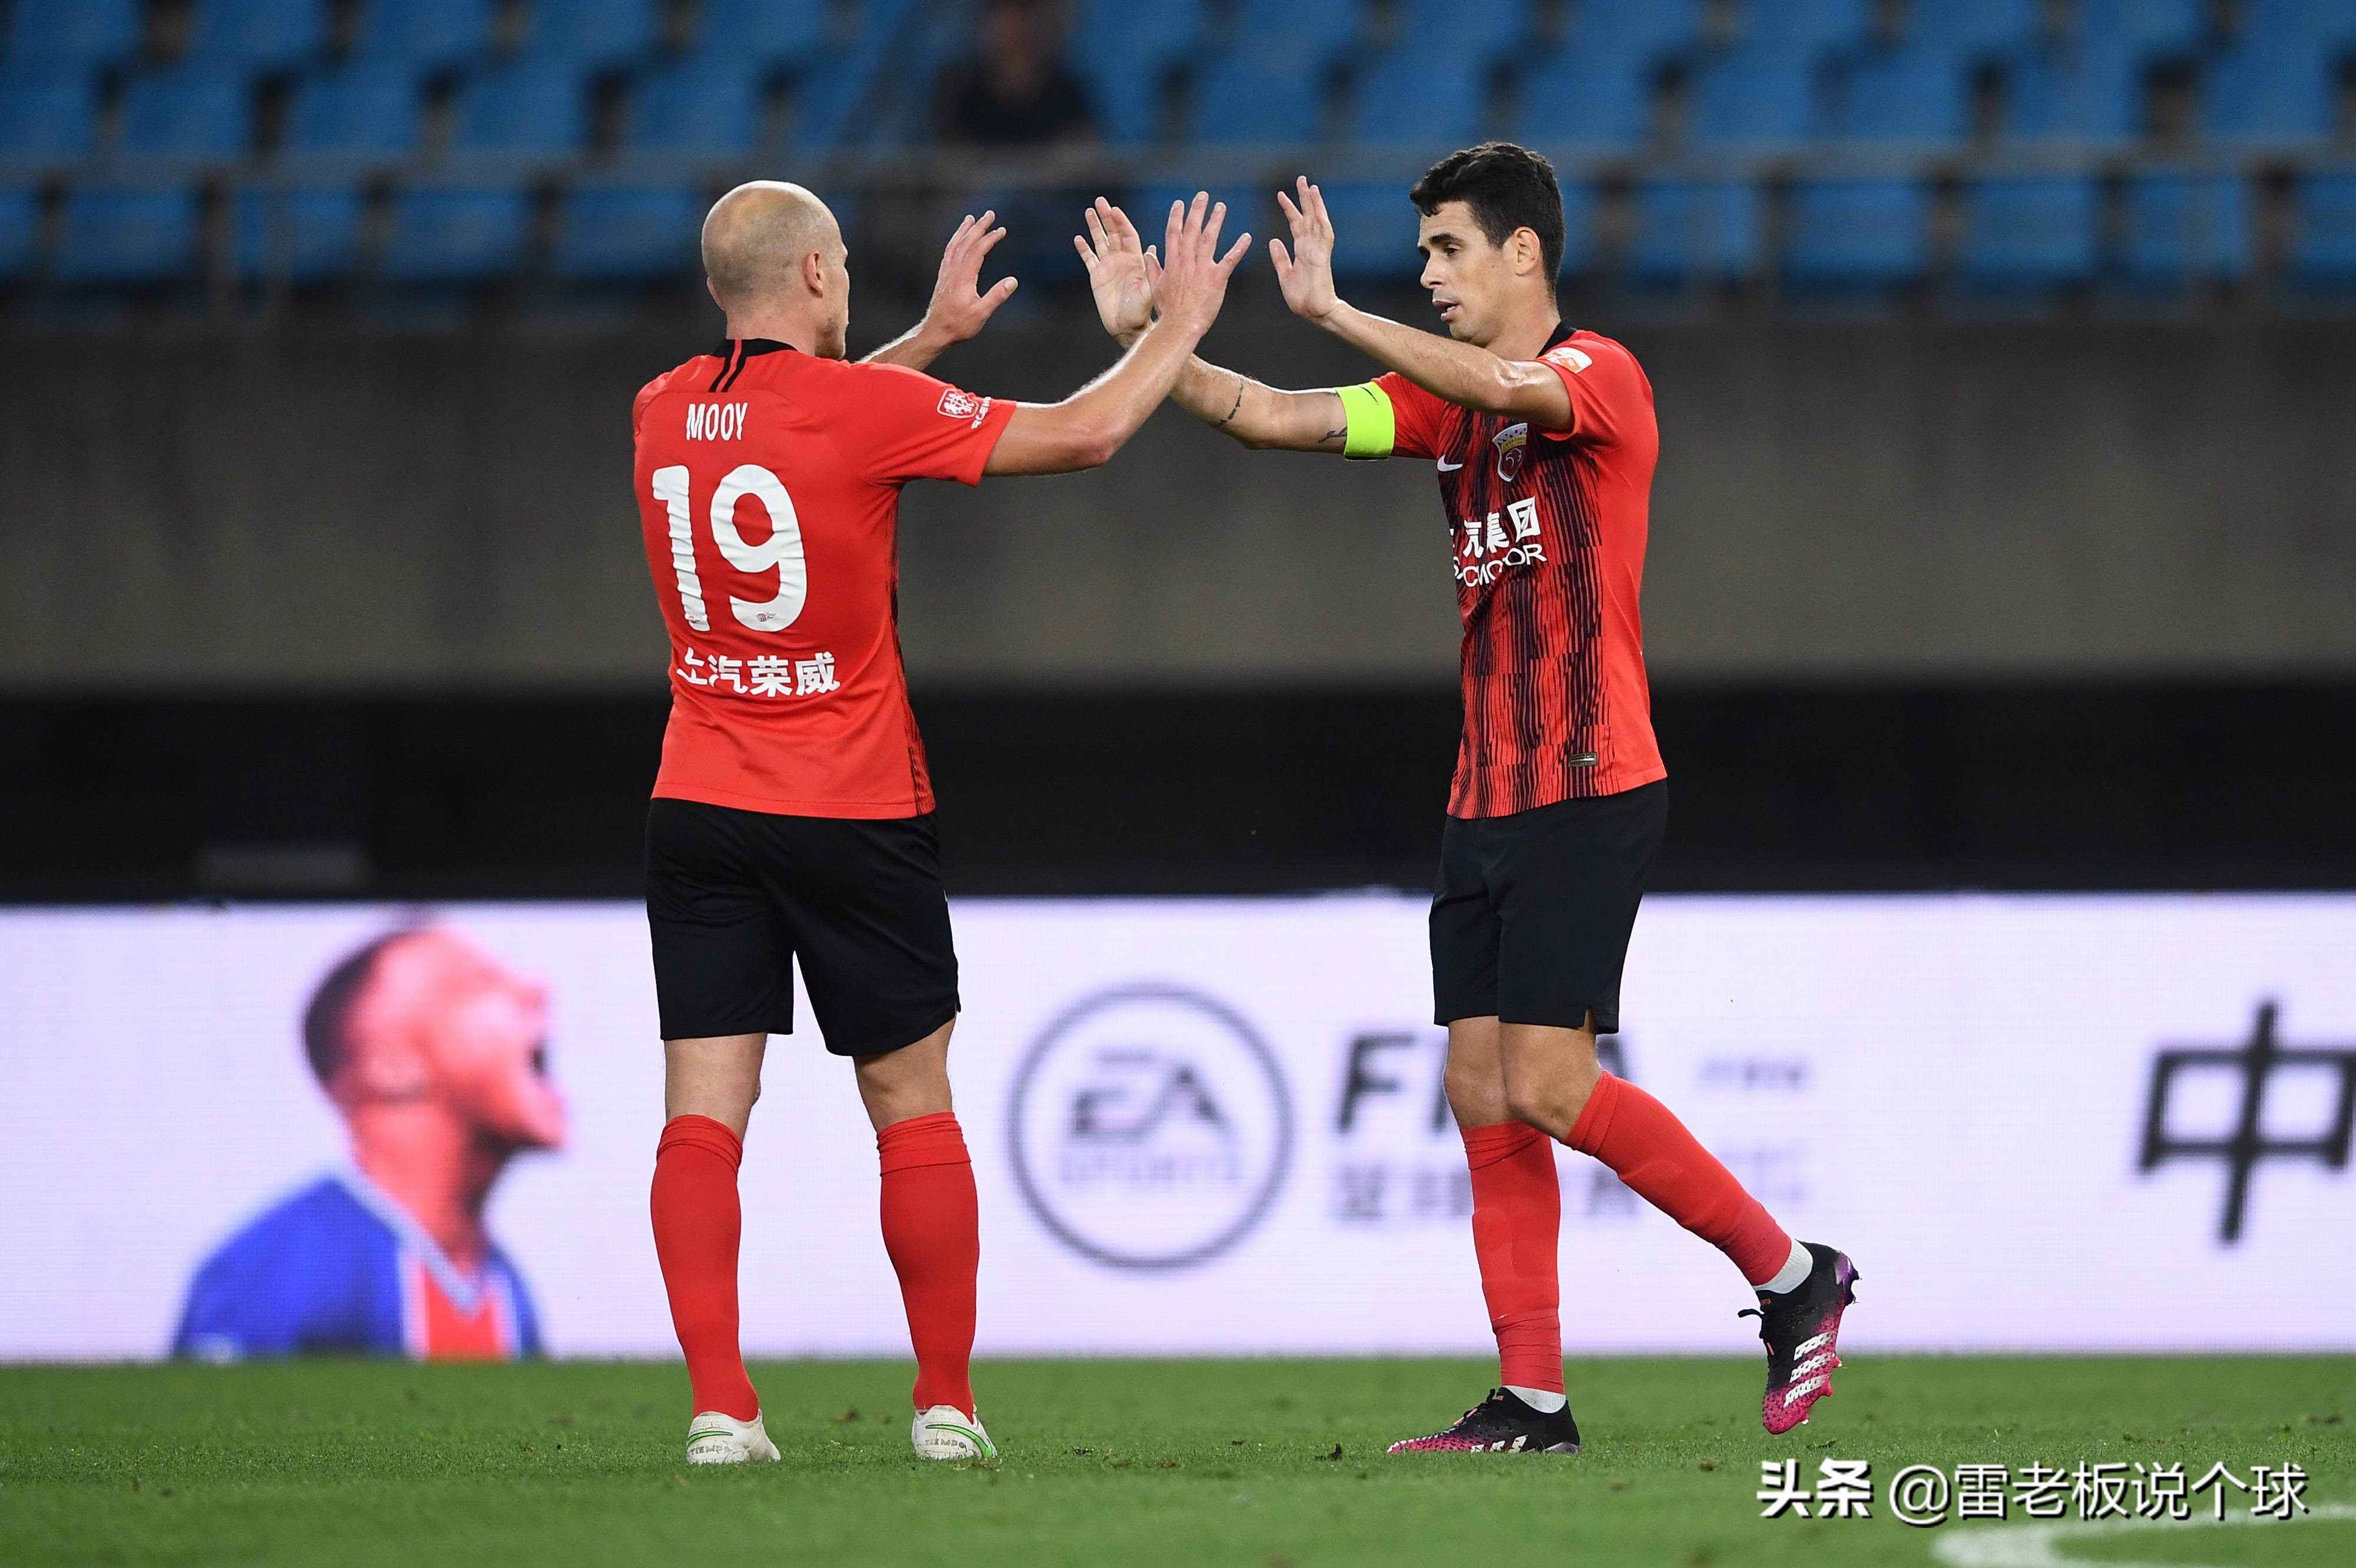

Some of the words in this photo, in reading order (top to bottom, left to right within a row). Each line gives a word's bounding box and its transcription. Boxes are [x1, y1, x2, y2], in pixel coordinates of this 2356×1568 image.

[686, 402, 748, 441] MOOY
[651, 464, 808, 632] 19
[676, 647, 841, 697] 上汽荣威
[1069, 1048, 1233, 1141] EA
[2138, 1000, 2356, 1243] 中
